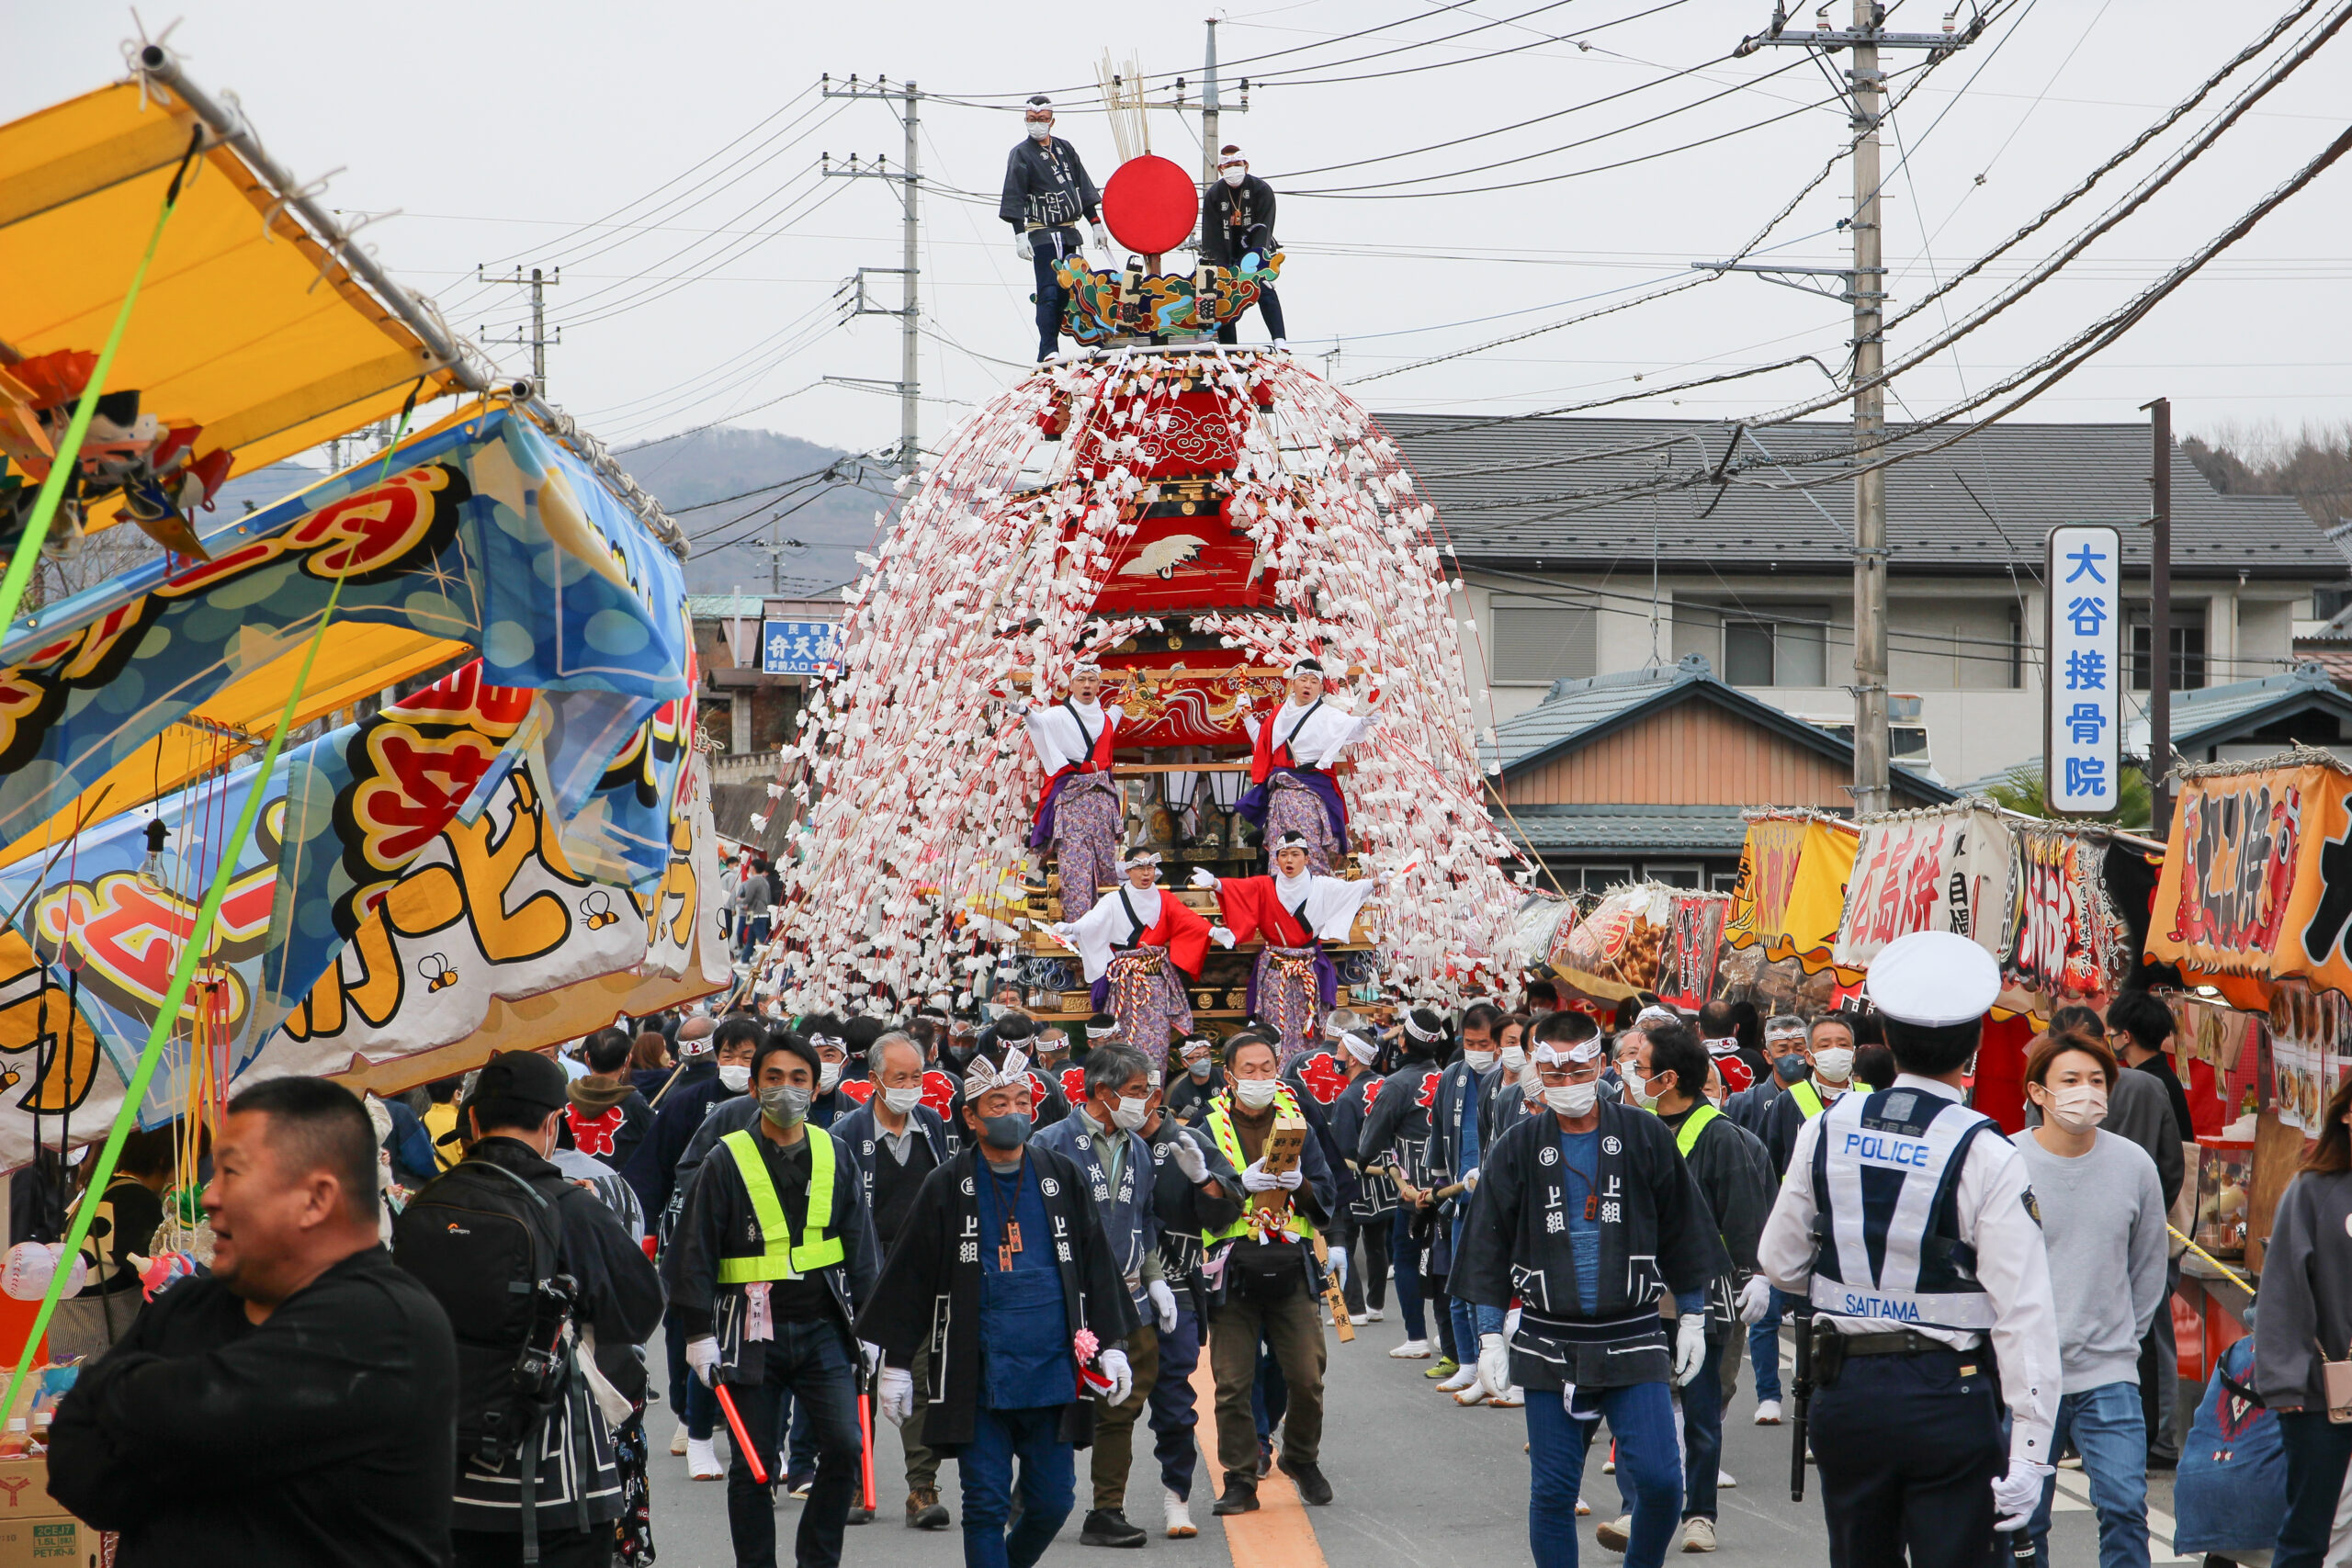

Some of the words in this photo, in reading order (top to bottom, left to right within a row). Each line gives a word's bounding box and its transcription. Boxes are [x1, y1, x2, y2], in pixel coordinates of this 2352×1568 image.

[1199, 269, 1217, 320] 上組
[767, 660, 808, 671] 手前入口
[2065, 544, 2107, 796] 大谷接骨院
[1849, 823, 1945, 949] 広島焼
[691, 1043, 701, 1054] 上
[1844, 1134, 1930, 1168] POLICE
[1544, 1185, 1566, 1235] 上組
[1601, 1175, 1622, 1224] 上組
[960, 1215, 978, 1263] 上組
[1054, 1215, 1072, 1263] 上組
[1846, 1293, 1920, 1321] SAITAMA
